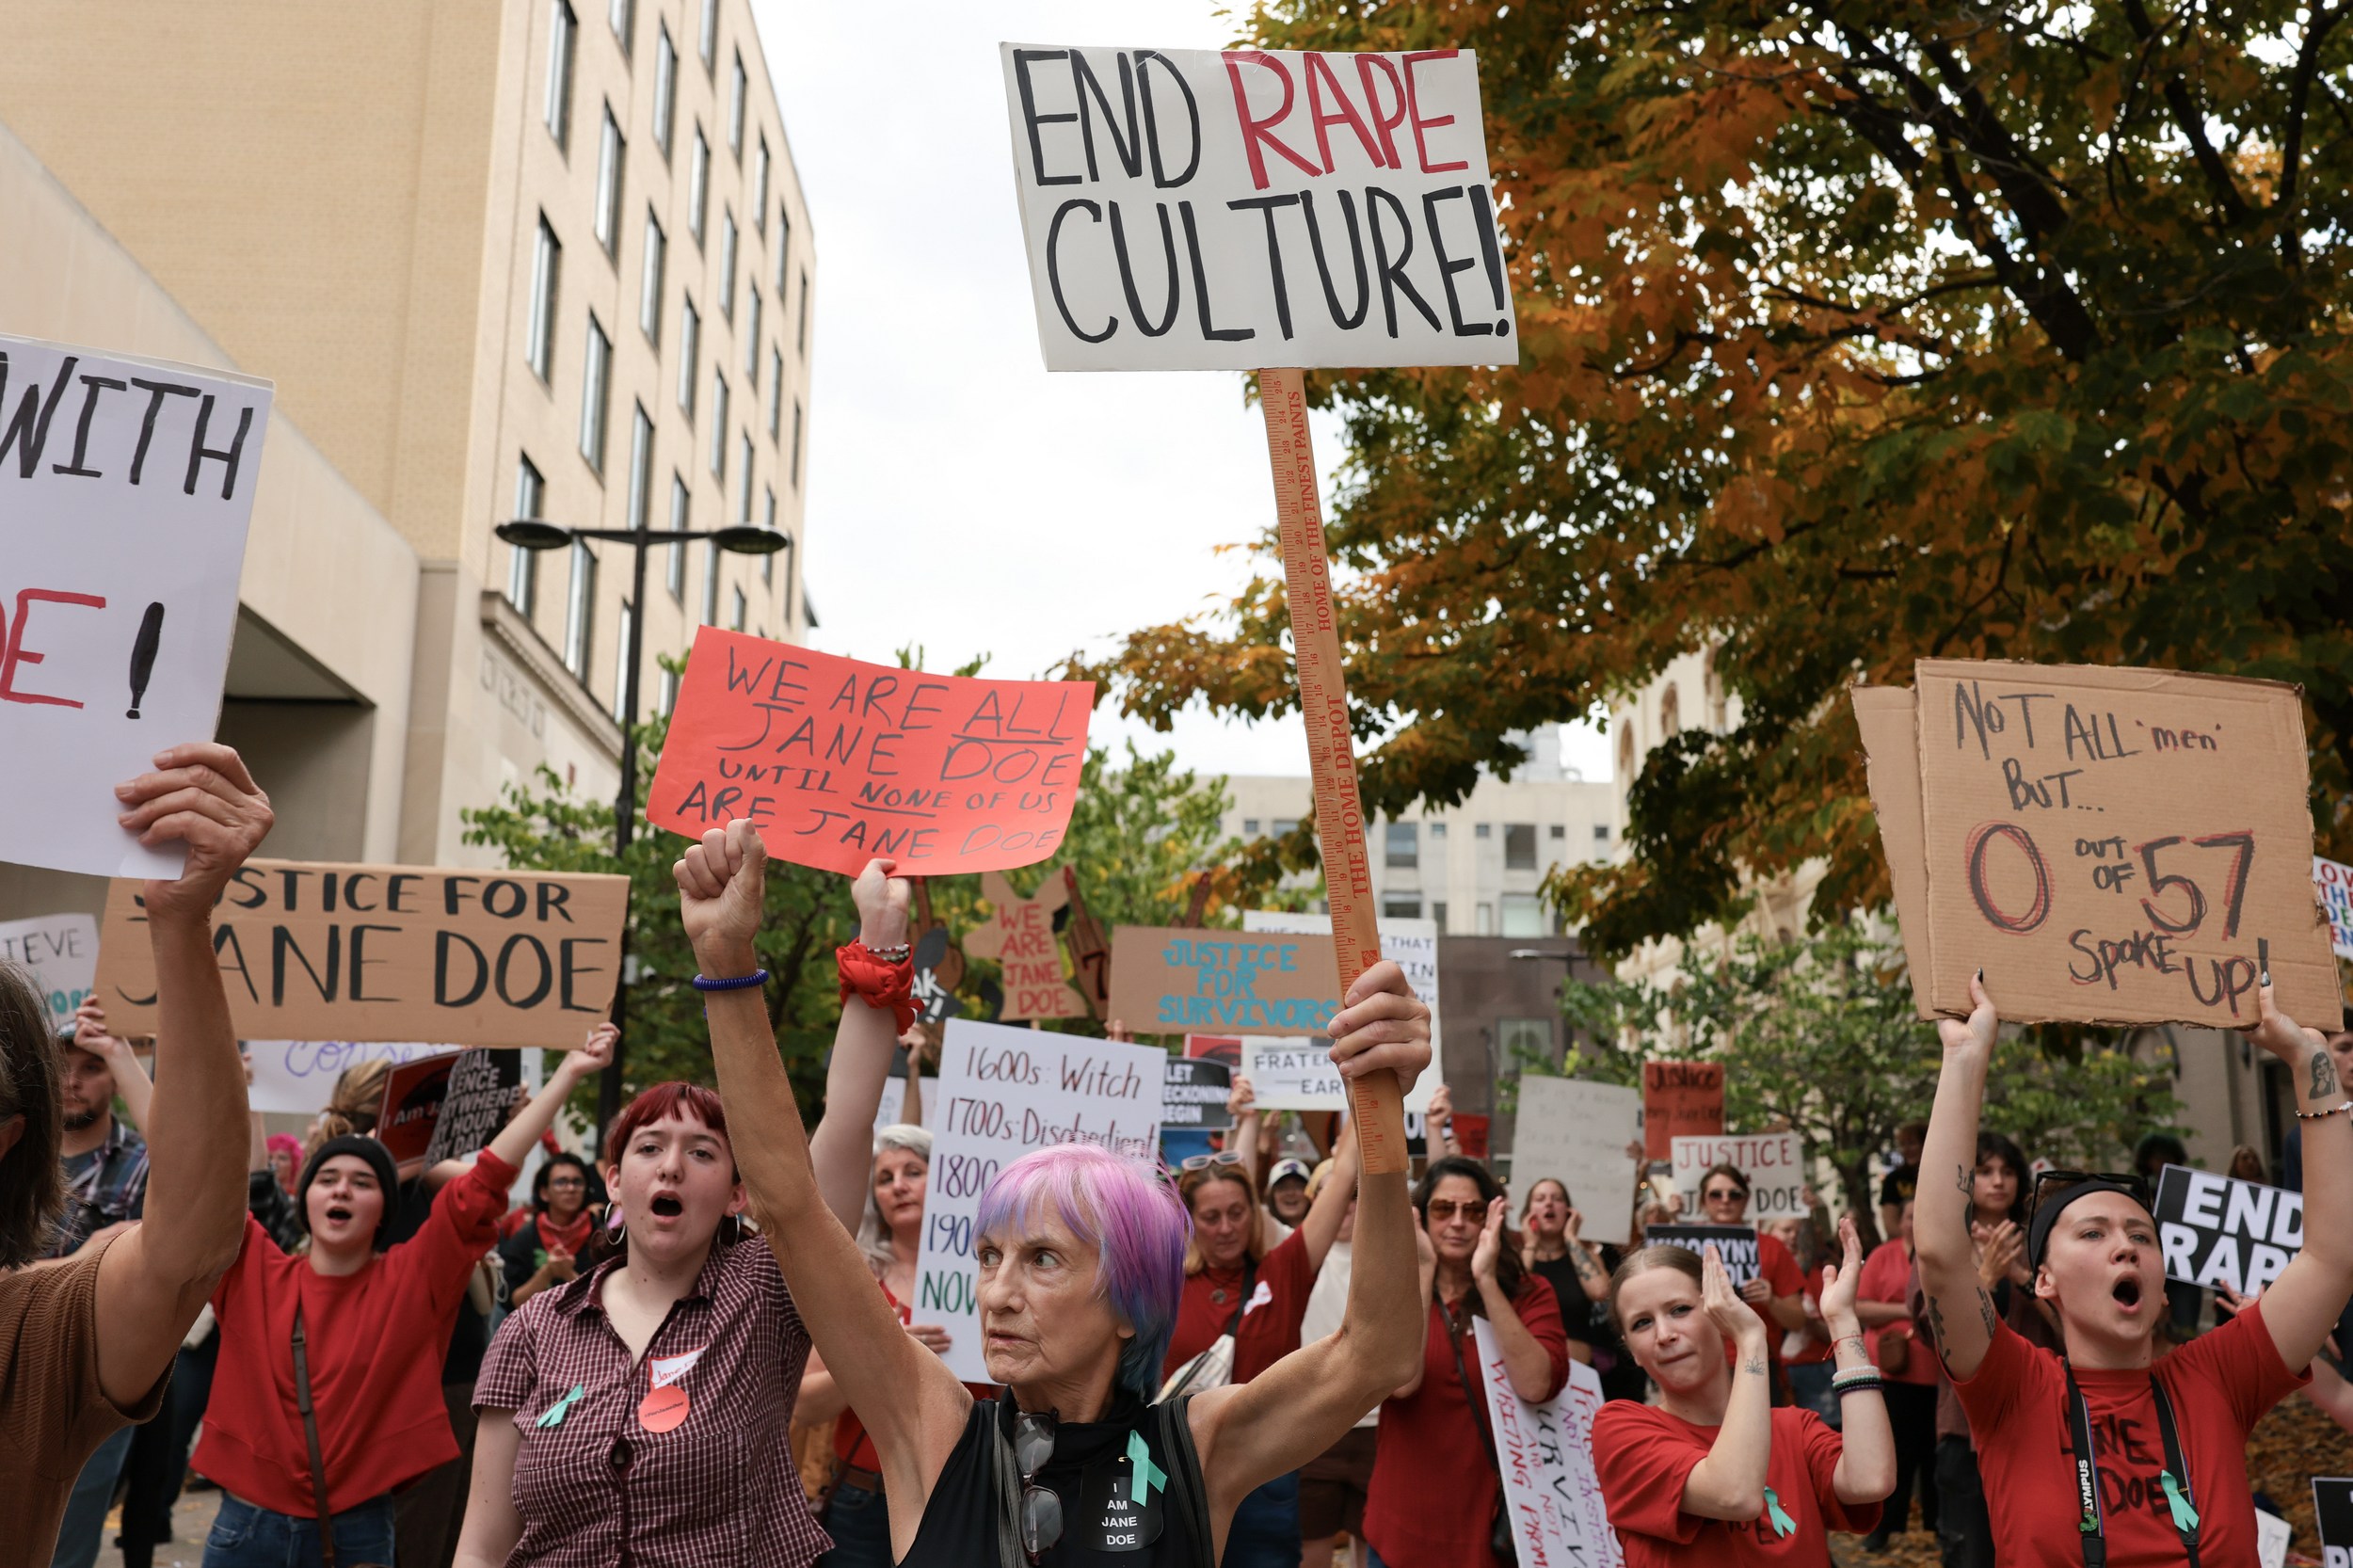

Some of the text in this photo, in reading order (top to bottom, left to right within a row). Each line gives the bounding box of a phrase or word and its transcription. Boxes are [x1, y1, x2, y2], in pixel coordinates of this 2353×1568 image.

[1014, 49, 1469, 189] END RAPE
[1047, 184, 1510, 343] CULTURE!
[1288, 391, 1331, 632] HOME OF THE FINEST PAINTS
[728, 646, 1074, 742] WE ARE ALL
[716, 703, 1075, 787] JANE DOE
[2064, 702, 2142, 760] ALL
[719, 758, 1058, 813] UNTIL NONE OF US
[1326, 695, 1369, 899] THE HOME DEPOT
[676, 780, 1059, 857] ARE JANE DOE
[2074, 836, 2127, 858] OUT
[134, 867, 576, 923] STICE FOR
[1964, 820, 2056, 936] 0
[2093, 862, 2137, 894] OF
[2133, 828, 2254, 941] 57
[999, 904, 1042, 930] WE
[1000, 927, 1050, 958] ARE
[1161, 939, 1299, 972] JUSTICE
[1391, 936, 1433, 950] THAT
[434, 930, 609, 1014] DOE
[1005, 960, 1063, 987] JANE
[1197, 966, 1257, 999] FOR
[1017, 987, 1070, 1016] DOE
[1158, 994, 1337, 1031] SURVIVORS
[967, 1047, 1141, 1098] 1600s: Witch
[1678, 1139, 1793, 1170] JUSTICE
[1756, 1186, 1801, 1213] DOE
[2183, 1172, 2304, 1248] END
[2160, 1222, 2298, 1299] RAP
[1107, 1499, 1128, 1511] AM
[2078, 1459, 2094, 1511] LYMPUS
[1101, 1516, 1137, 1528] JANE
[1106, 1534, 1136, 1545] DOE
